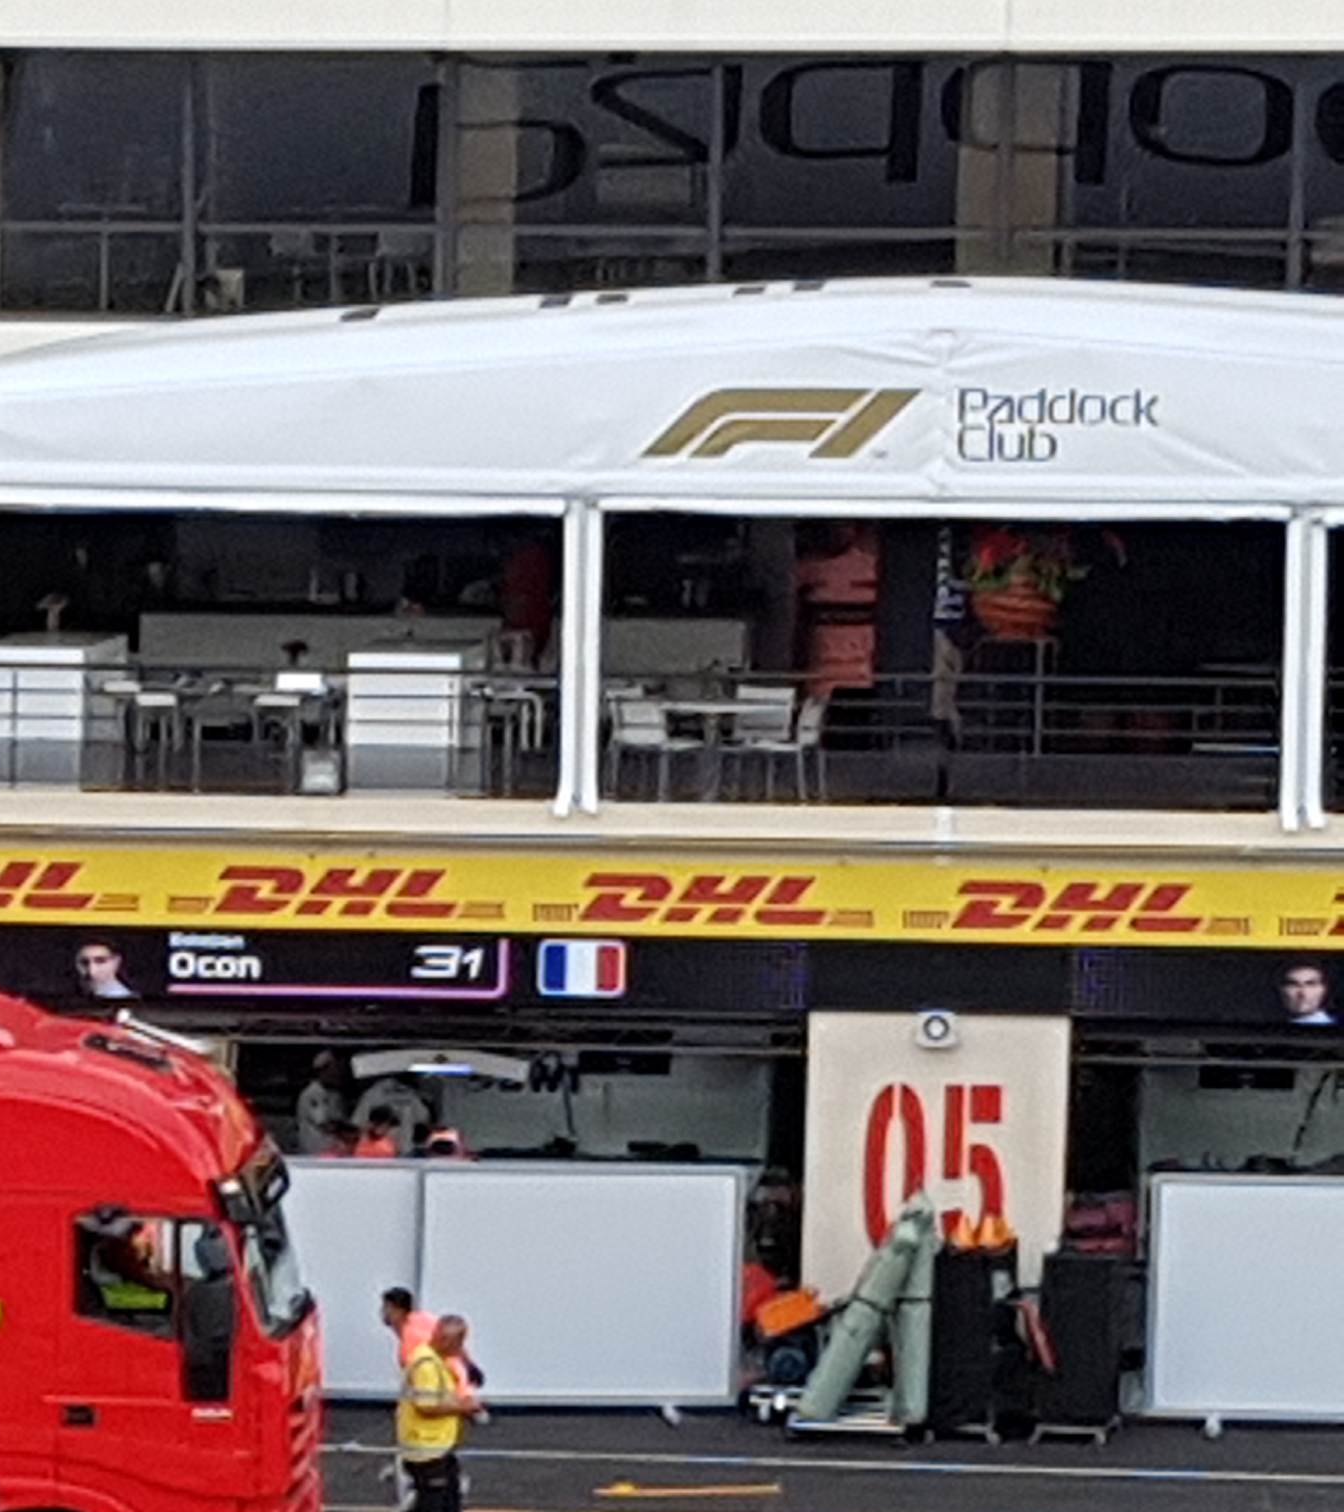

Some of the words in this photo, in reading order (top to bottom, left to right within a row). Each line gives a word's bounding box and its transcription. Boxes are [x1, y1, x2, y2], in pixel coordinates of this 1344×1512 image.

[640, 388, 922, 459] F1
[957, 387, 1159, 426] Paddock
[957, 424, 1057, 462] Club
[215, 866, 457, 917] DHL
[582, 874, 827, 925] DHL
[952, 881, 1203, 932] DHL
[168, 951, 262, 979] Ocon
[412, 945, 483, 979] 31
[864, 1082, 1004, 1250] 05
